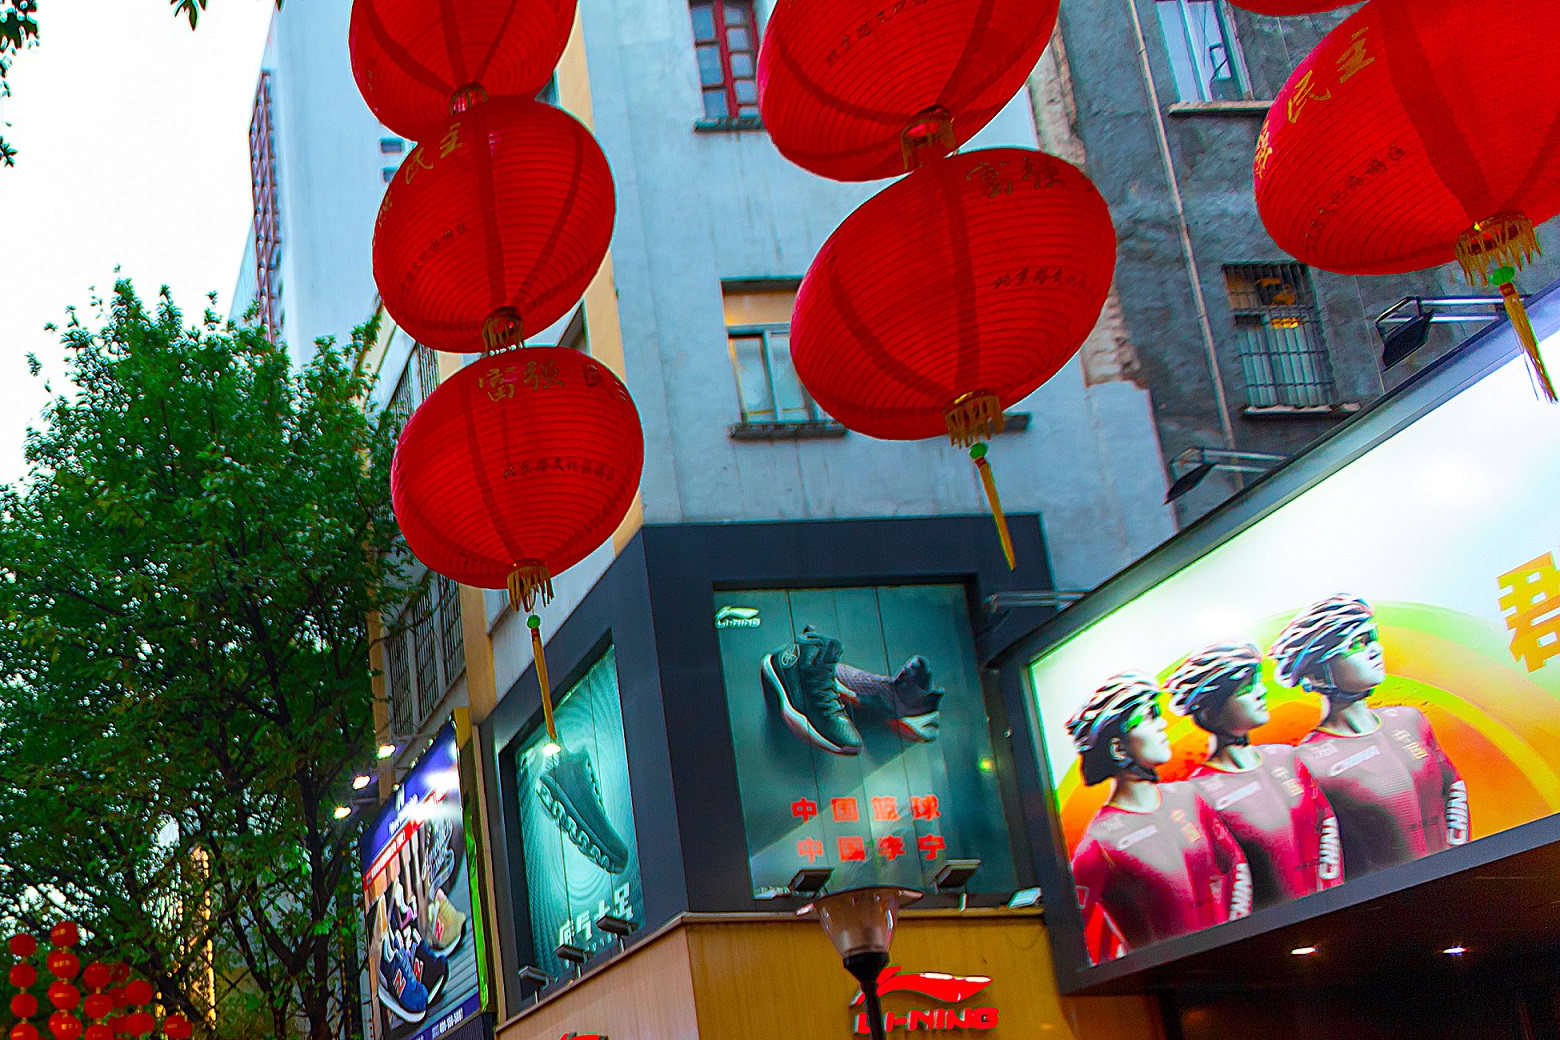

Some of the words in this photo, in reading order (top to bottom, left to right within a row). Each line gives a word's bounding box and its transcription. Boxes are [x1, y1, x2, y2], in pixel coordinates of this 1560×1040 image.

[791, 794, 941, 823] 中国篮球
[797, 833, 947, 862] 中国李宁
[854, 1007, 1000, 1035] LI-NING
